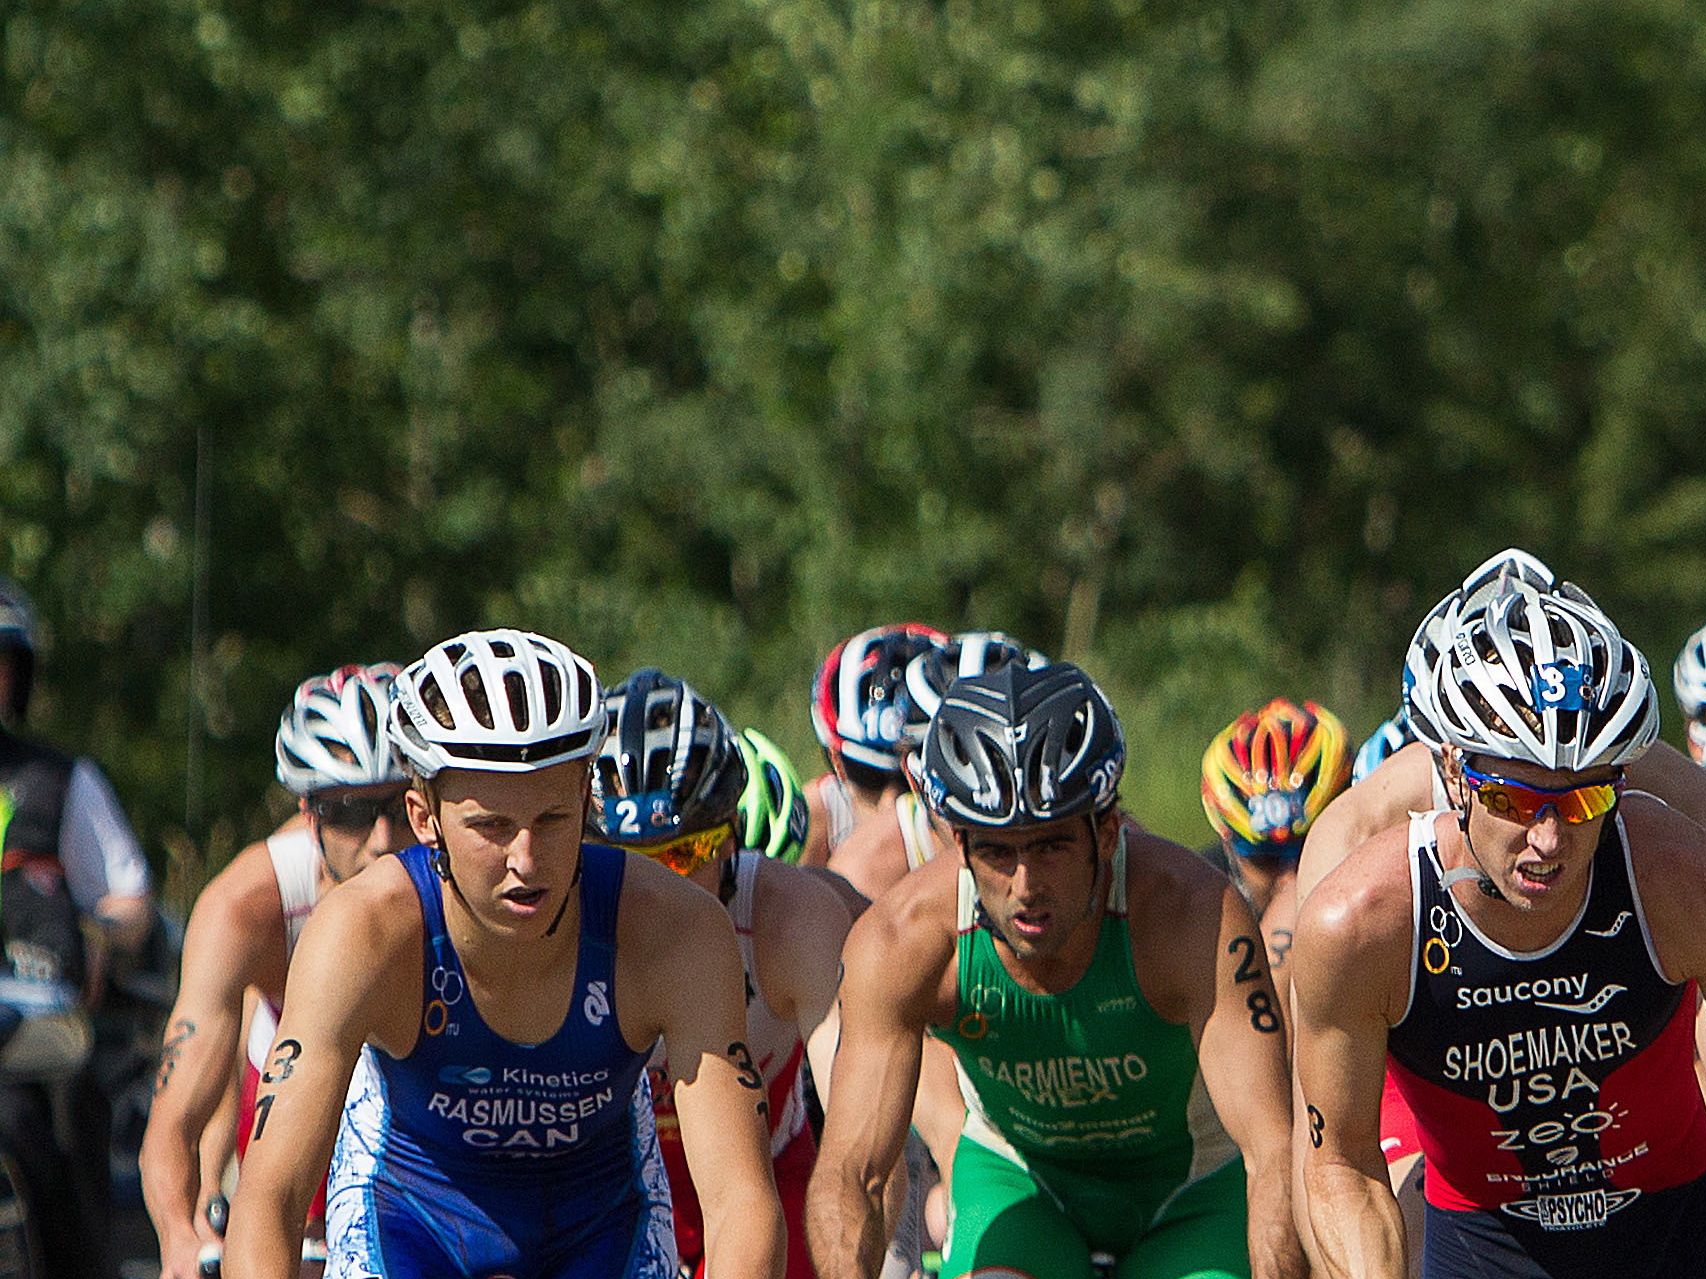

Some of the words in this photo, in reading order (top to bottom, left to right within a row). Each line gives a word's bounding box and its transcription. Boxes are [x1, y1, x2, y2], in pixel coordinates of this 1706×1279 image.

[1541, 667, 1566, 702] 3
[615, 801, 640, 834] 2
[1456, 973, 1589, 1010] saucony
[1443, 1021, 1638, 1082] SHOEMAKER
[503, 1067, 609, 1088] Kinetico
[977, 1053, 1148, 1101] SARMIENTO
[1488, 1066, 1600, 1113] USA
[427, 1087, 613, 1127] RASMUSSEN
[462, 1123, 579, 1148] CAN
[1549, 1191, 1606, 1227] PSYCHO
